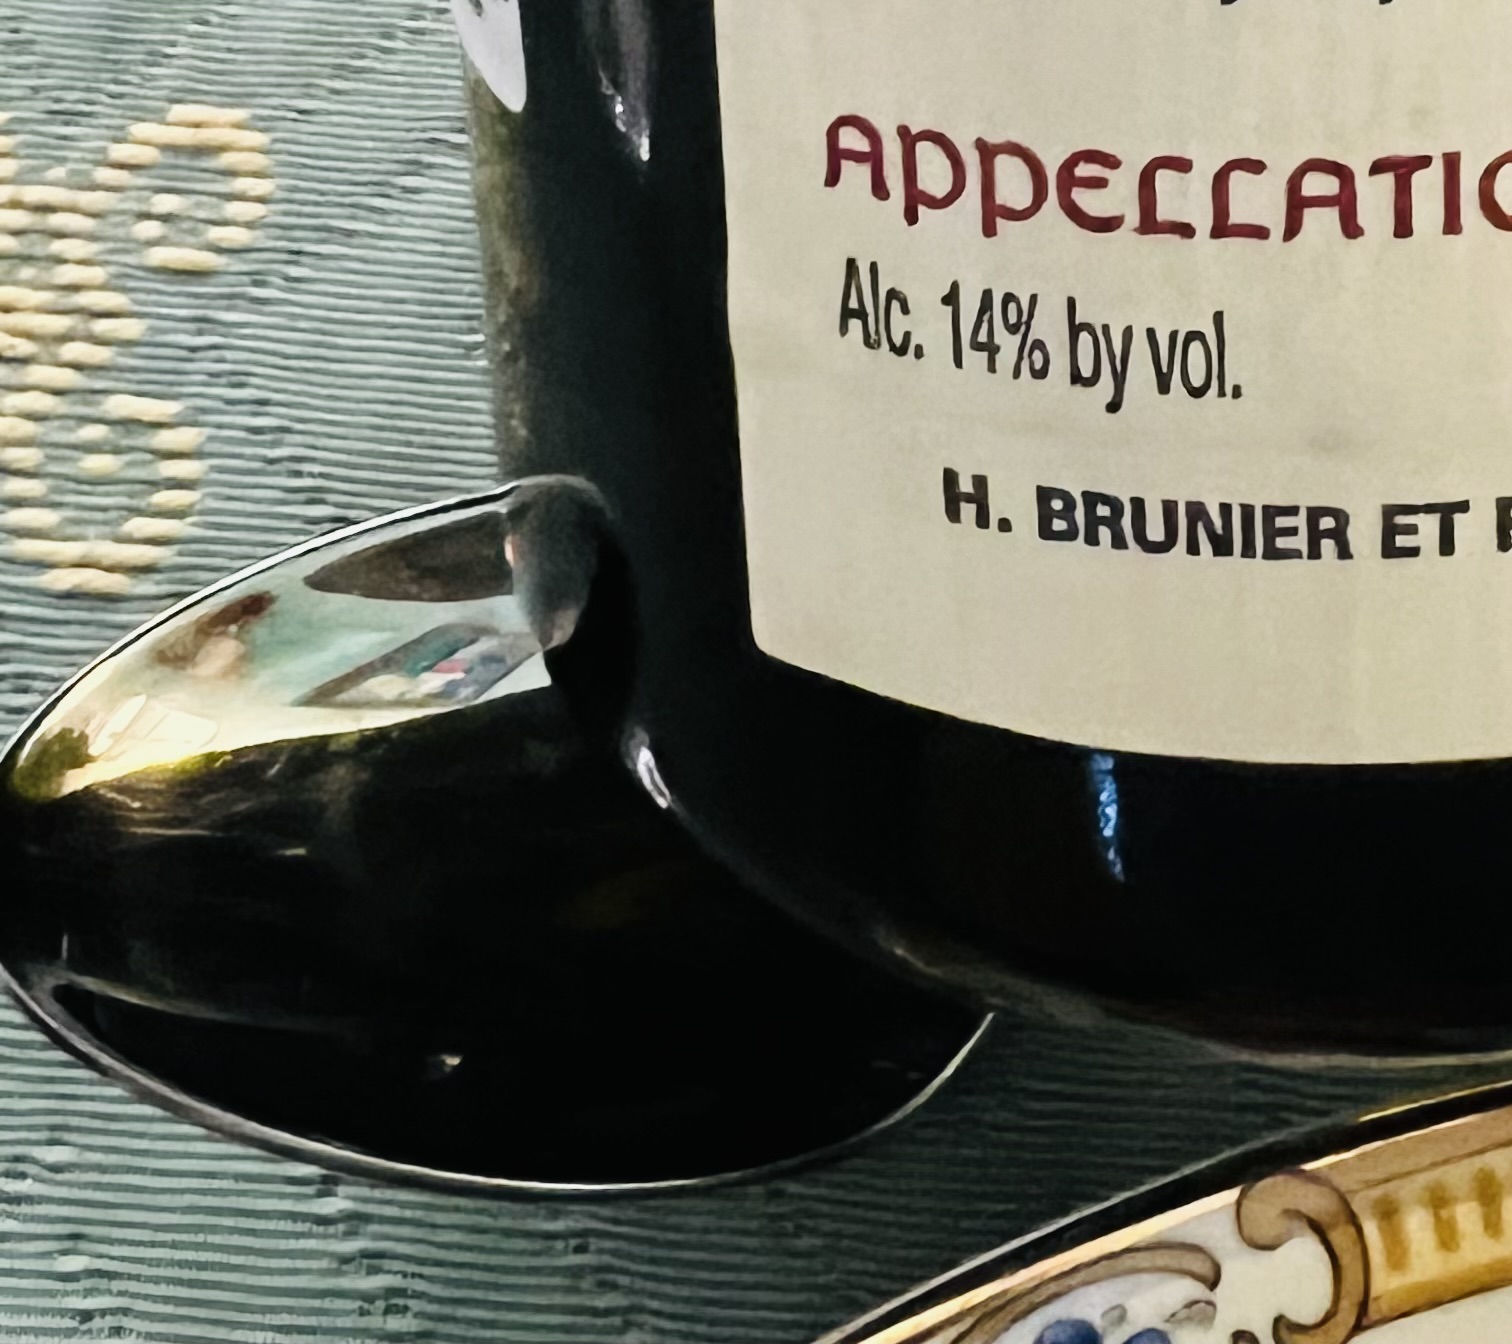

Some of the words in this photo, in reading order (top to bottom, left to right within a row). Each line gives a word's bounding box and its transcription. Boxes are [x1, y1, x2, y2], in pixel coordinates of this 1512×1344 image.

[838, 256, 925, 360] Alc.
[940, 279, 1051, 380] 14%
[1066, 295, 1133, 414] by
[1147, 308, 1243, 400] vol.
[941, 465, 1014, 535] H.
[1035, 483, 1354, 561] BRUNIER
[1379, 498, 1470, 561] ET
